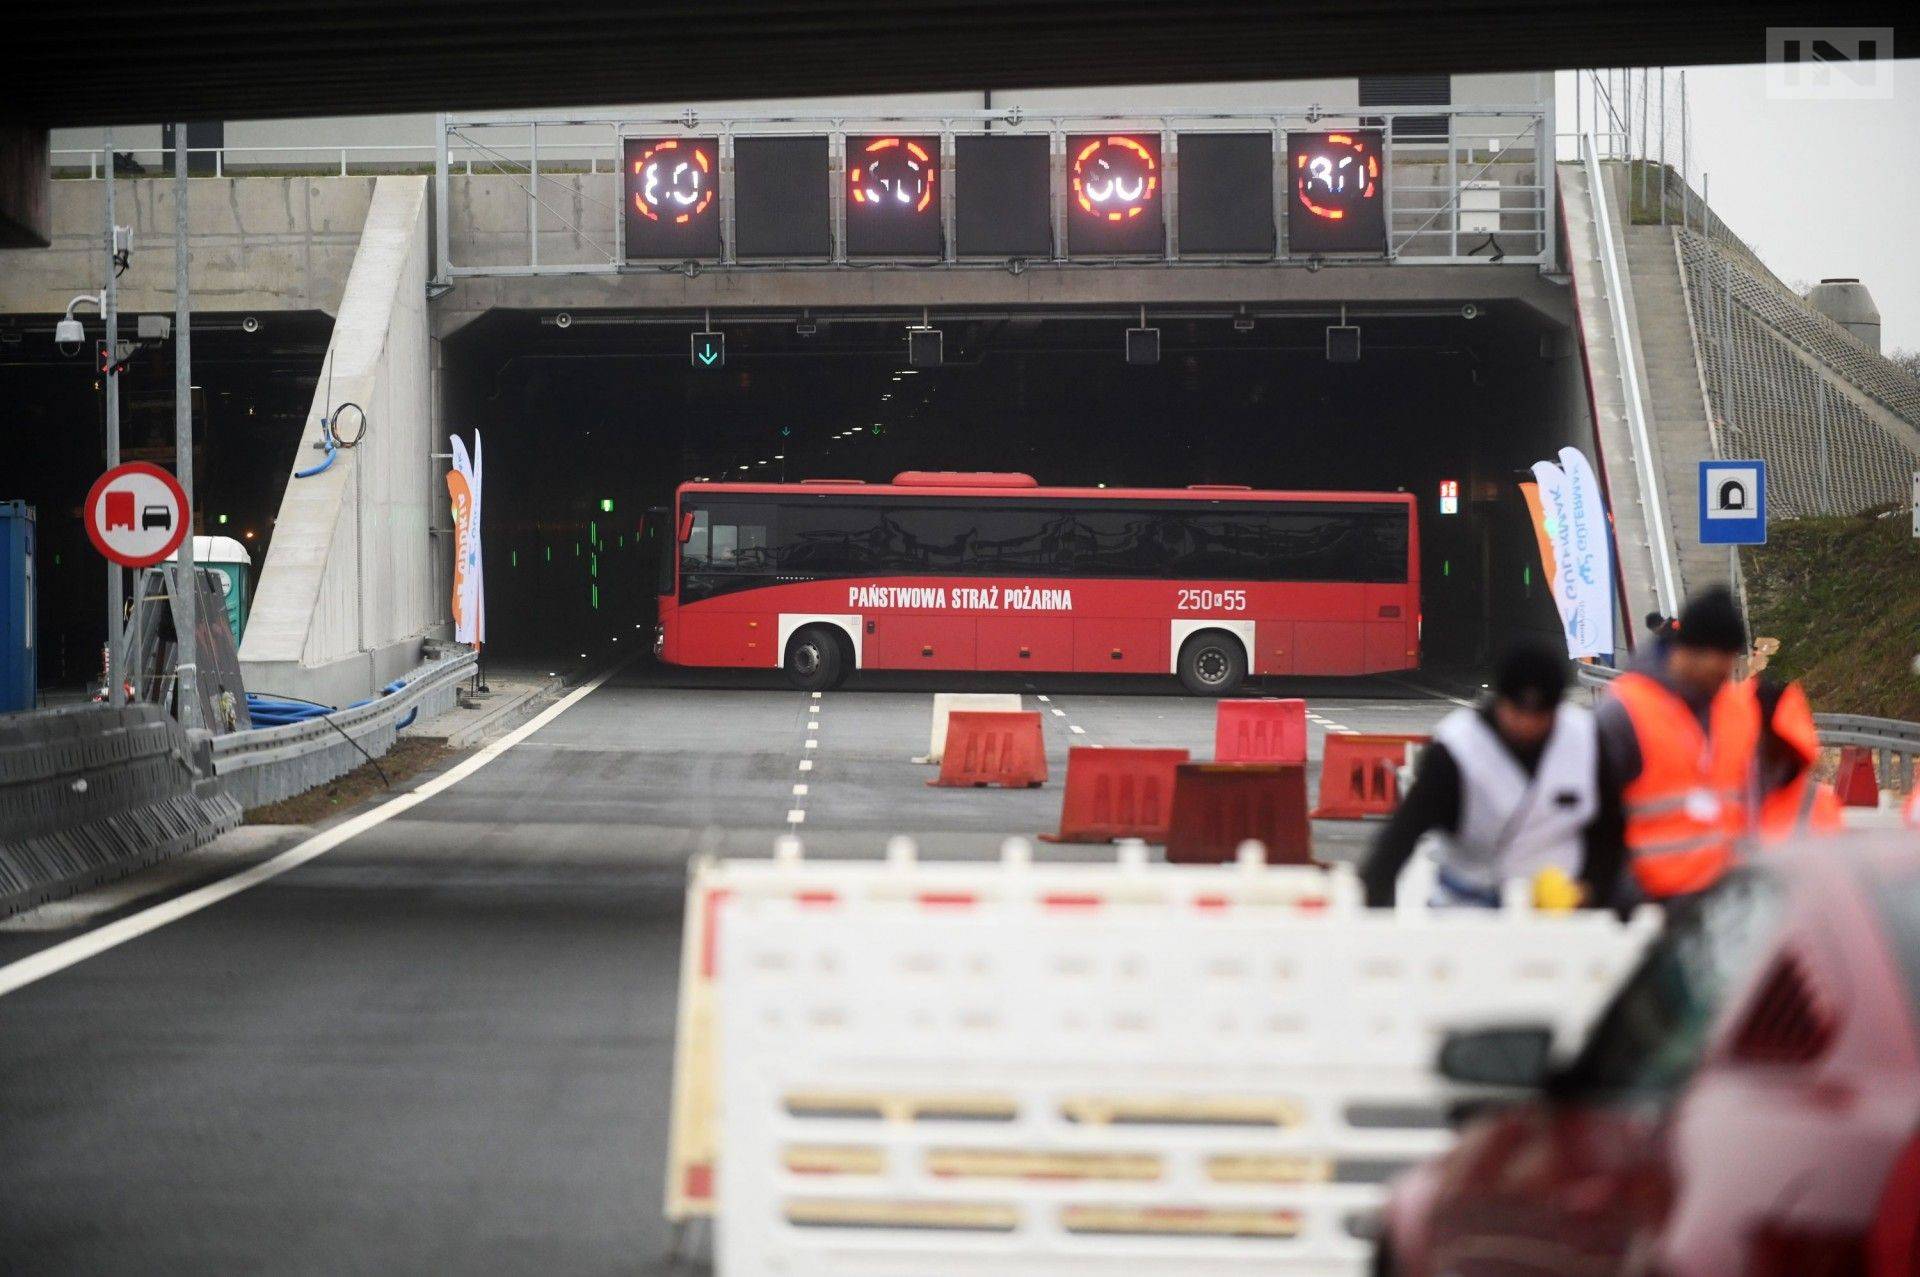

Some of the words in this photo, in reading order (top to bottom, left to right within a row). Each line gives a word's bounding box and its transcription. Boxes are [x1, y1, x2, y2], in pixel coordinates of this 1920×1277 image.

[849, 585, 946, 609] PAŃSTWOWA
[951, 585, 999, 610] STRAŻ
[1004, 586, 1073, 611] POŻARNA
